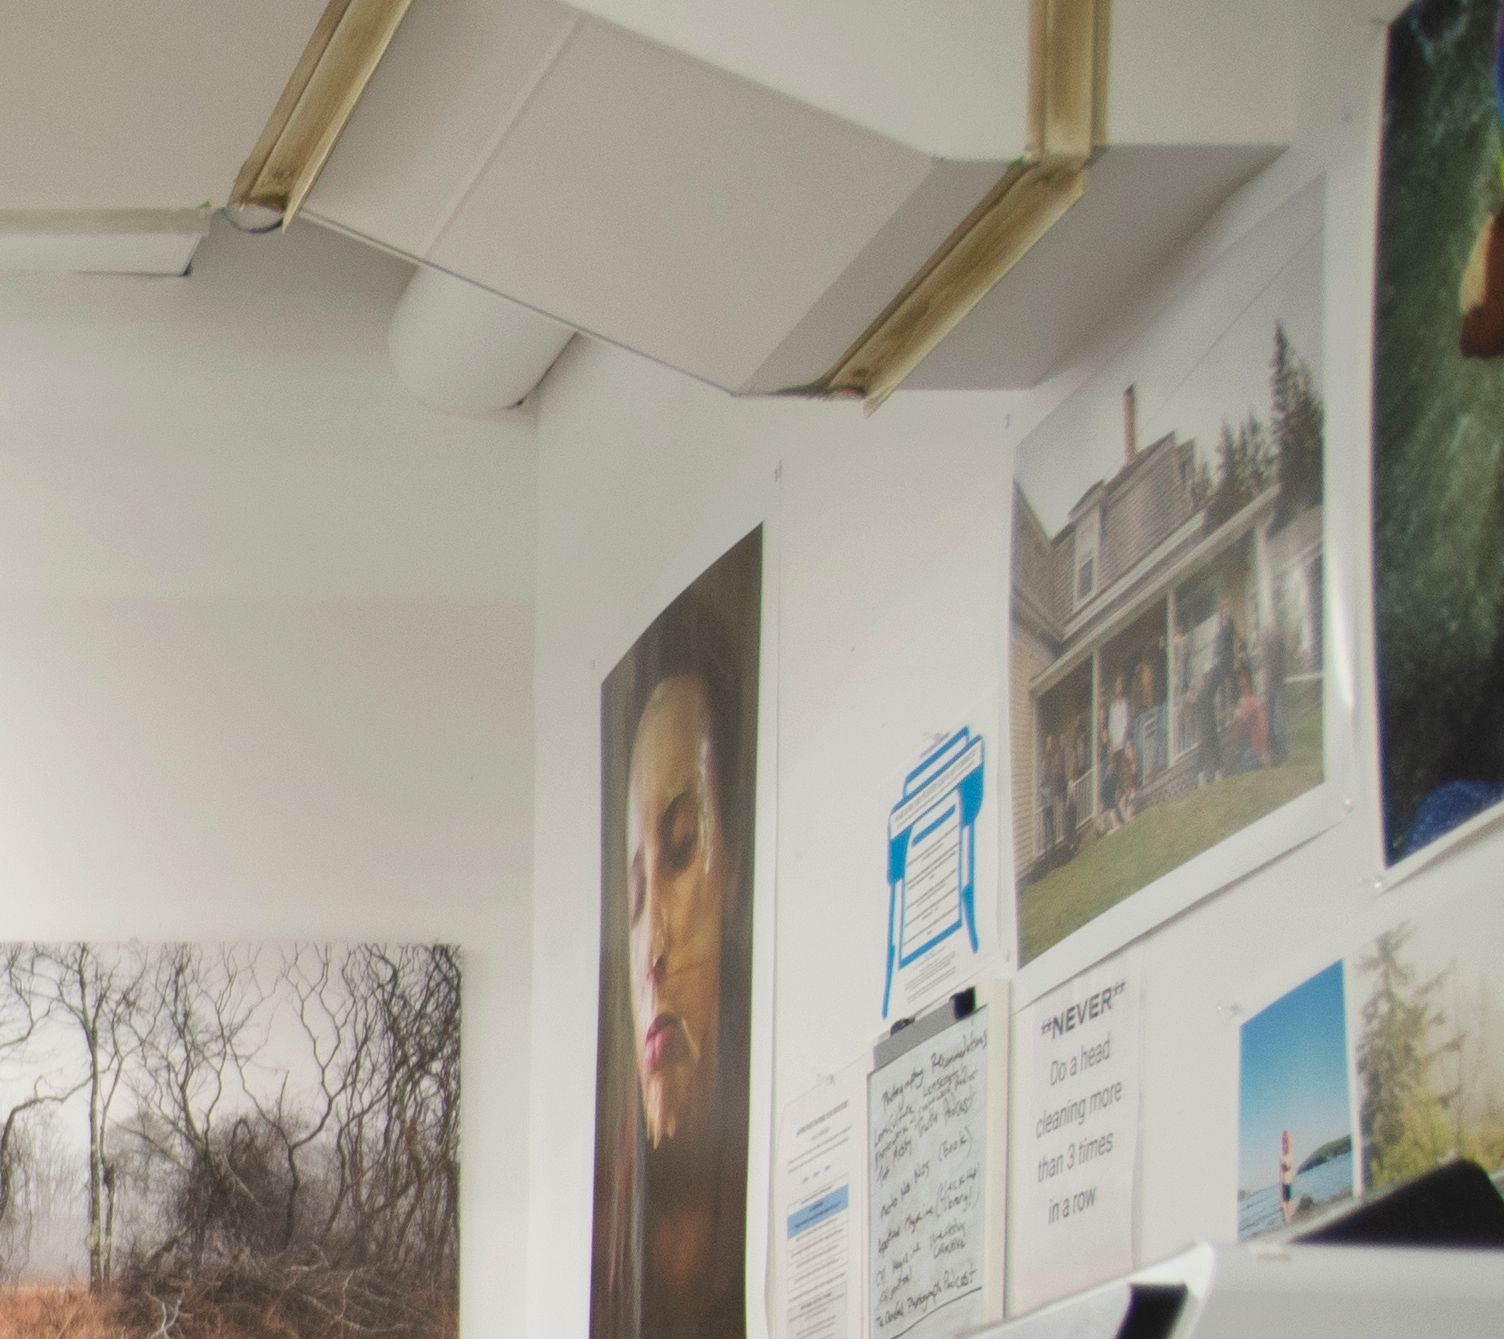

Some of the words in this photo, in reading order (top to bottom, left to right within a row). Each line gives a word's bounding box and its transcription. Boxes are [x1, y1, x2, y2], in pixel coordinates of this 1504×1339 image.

[1049, 1059, 1066, 1086] Do
[1069, 1057, 1078, 1076] a
[1080, 1032, 1111, 1072] head
[1035, 1097, 1086, 1140] cleaning
[1089, 1080, 1123, 1113] more
[1038, 1155, 1064, 1183] than
[1067, 1143, 1077, 1170] 3
[1078, 1132, 1114, 1163] times
[1048, 1199, 1060, 1225] in
[1062, 1197, 1071, 1218] a
[1073, 1186, 1097, 1215] row
